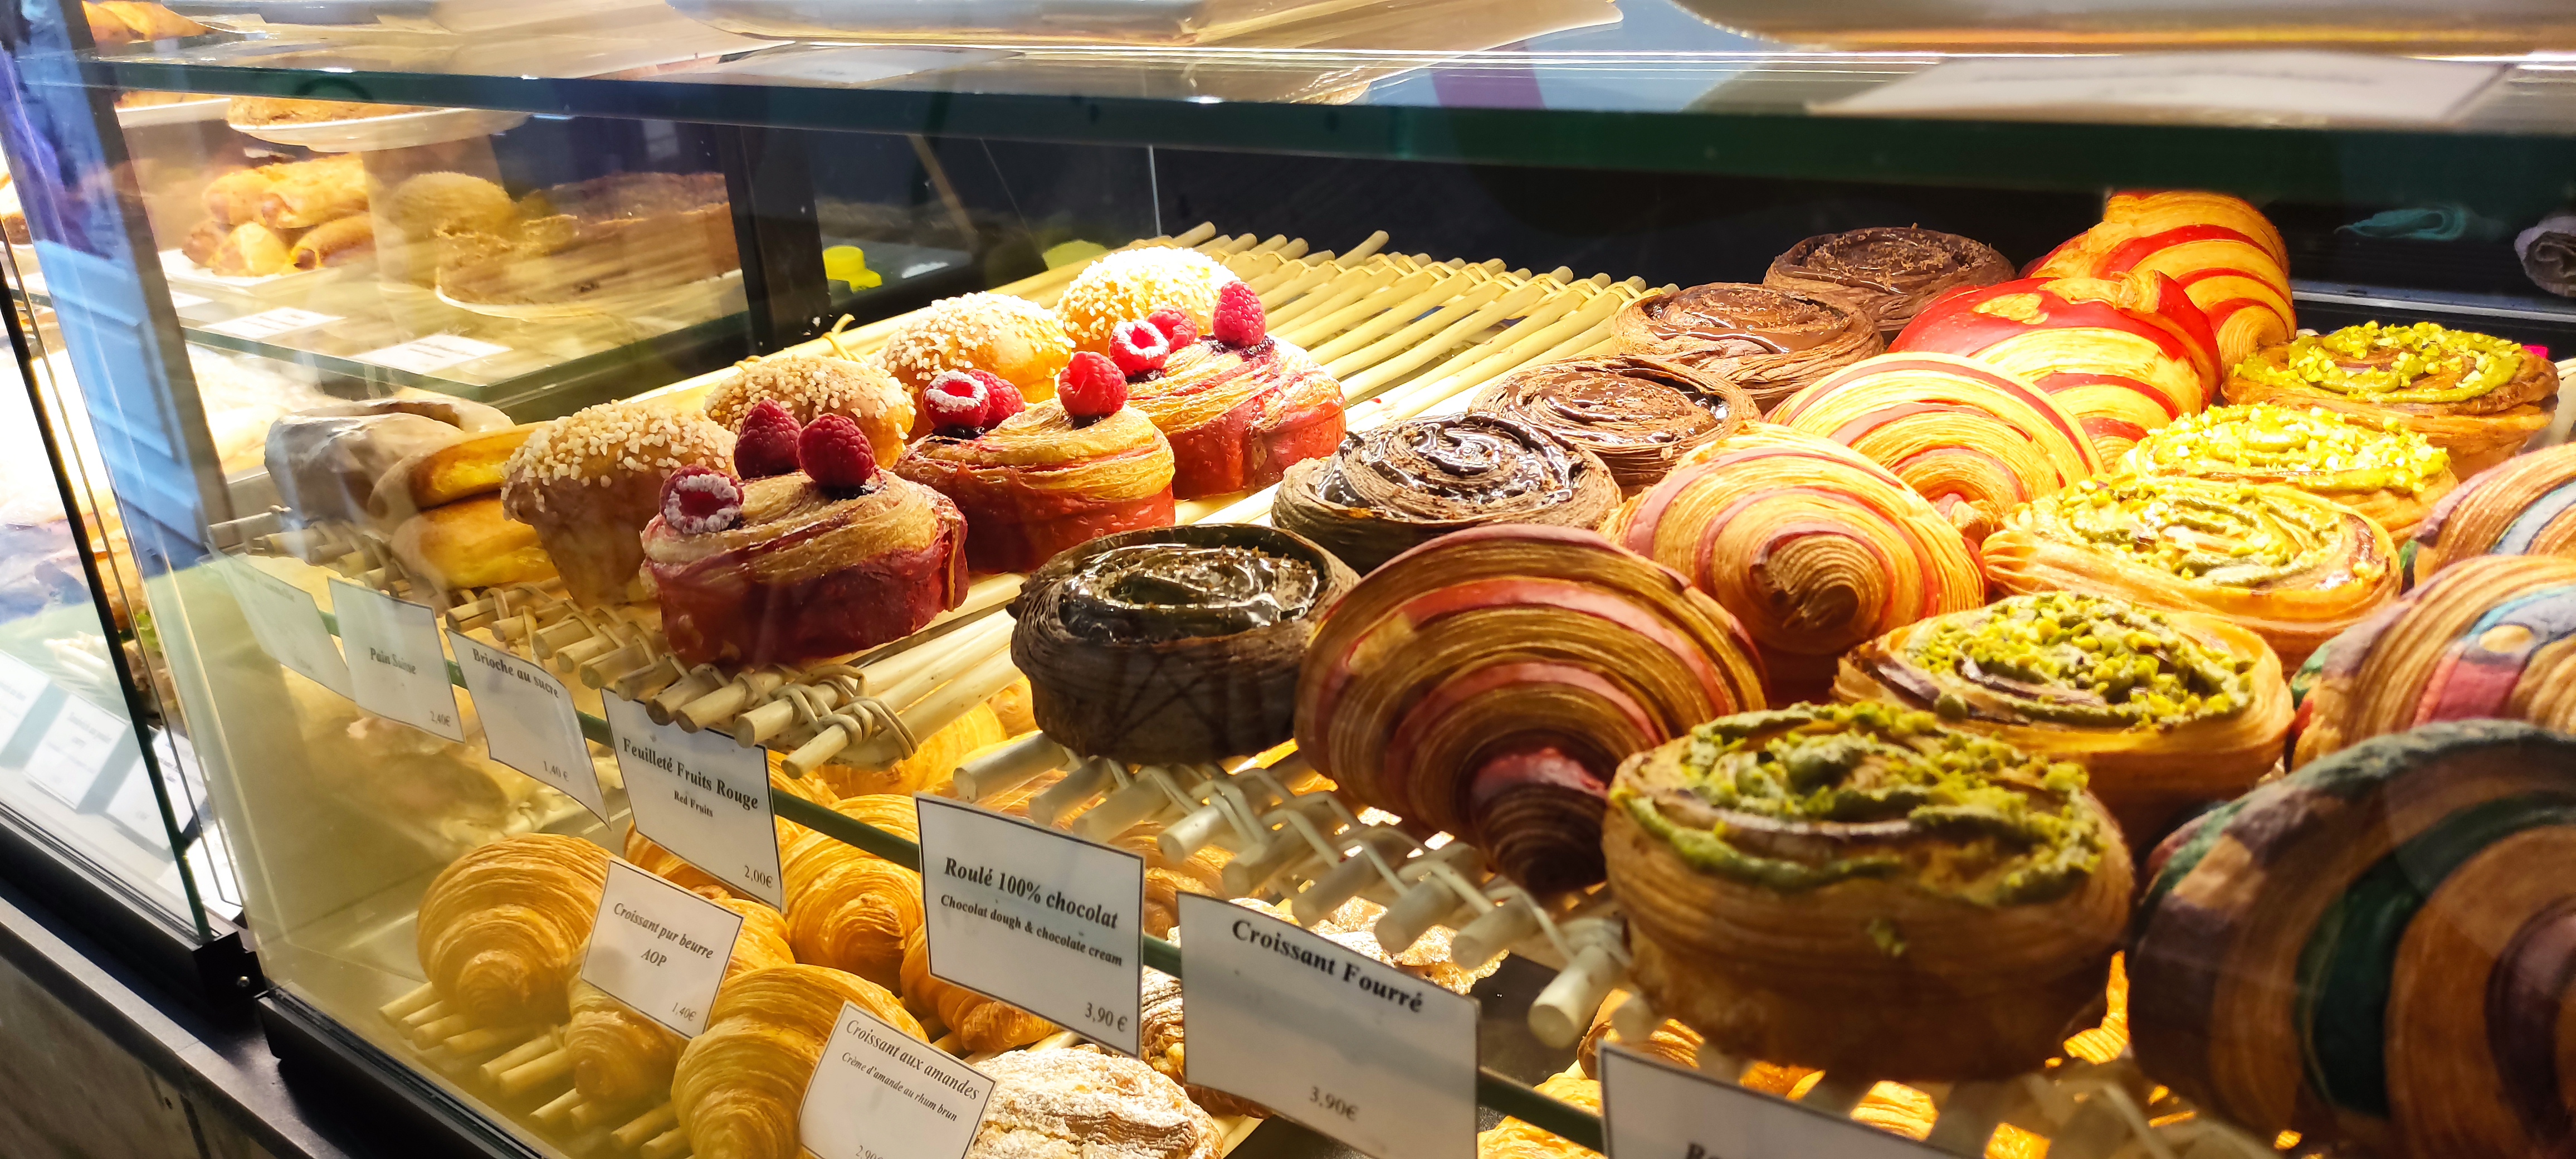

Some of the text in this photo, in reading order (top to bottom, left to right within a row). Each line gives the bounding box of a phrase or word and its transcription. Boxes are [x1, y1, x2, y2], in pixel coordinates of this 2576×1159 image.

[370, 647, 391, 665] Pain
[472, 648, 559, 698] Brioche au sucre
[622, 737, 759, 811] Feuilleté Fruits Rouge
[674, 790, 714, 817] Red Fruits
[744, 865, 773, 889] 2,00€
[944, 856, 1119, 930] Roulé 100% chocolat
[613, 902, 714, 959] Croissant pur beurre
[940, 894, 1123, 967] Chocolat dough & chocolate cream
[641, 948, 667, 967] AOP
[1232, 919, 1424, 1014] Croissant Fourré
[671, 1002, 697, 1021] 1,40€
[1117, 1017, 1128, 1033] €
[846, 1020, 980, 1100] Croissant aux amandes
[841, 1052, 958, 1122] Crème d'amande au rhum brun
